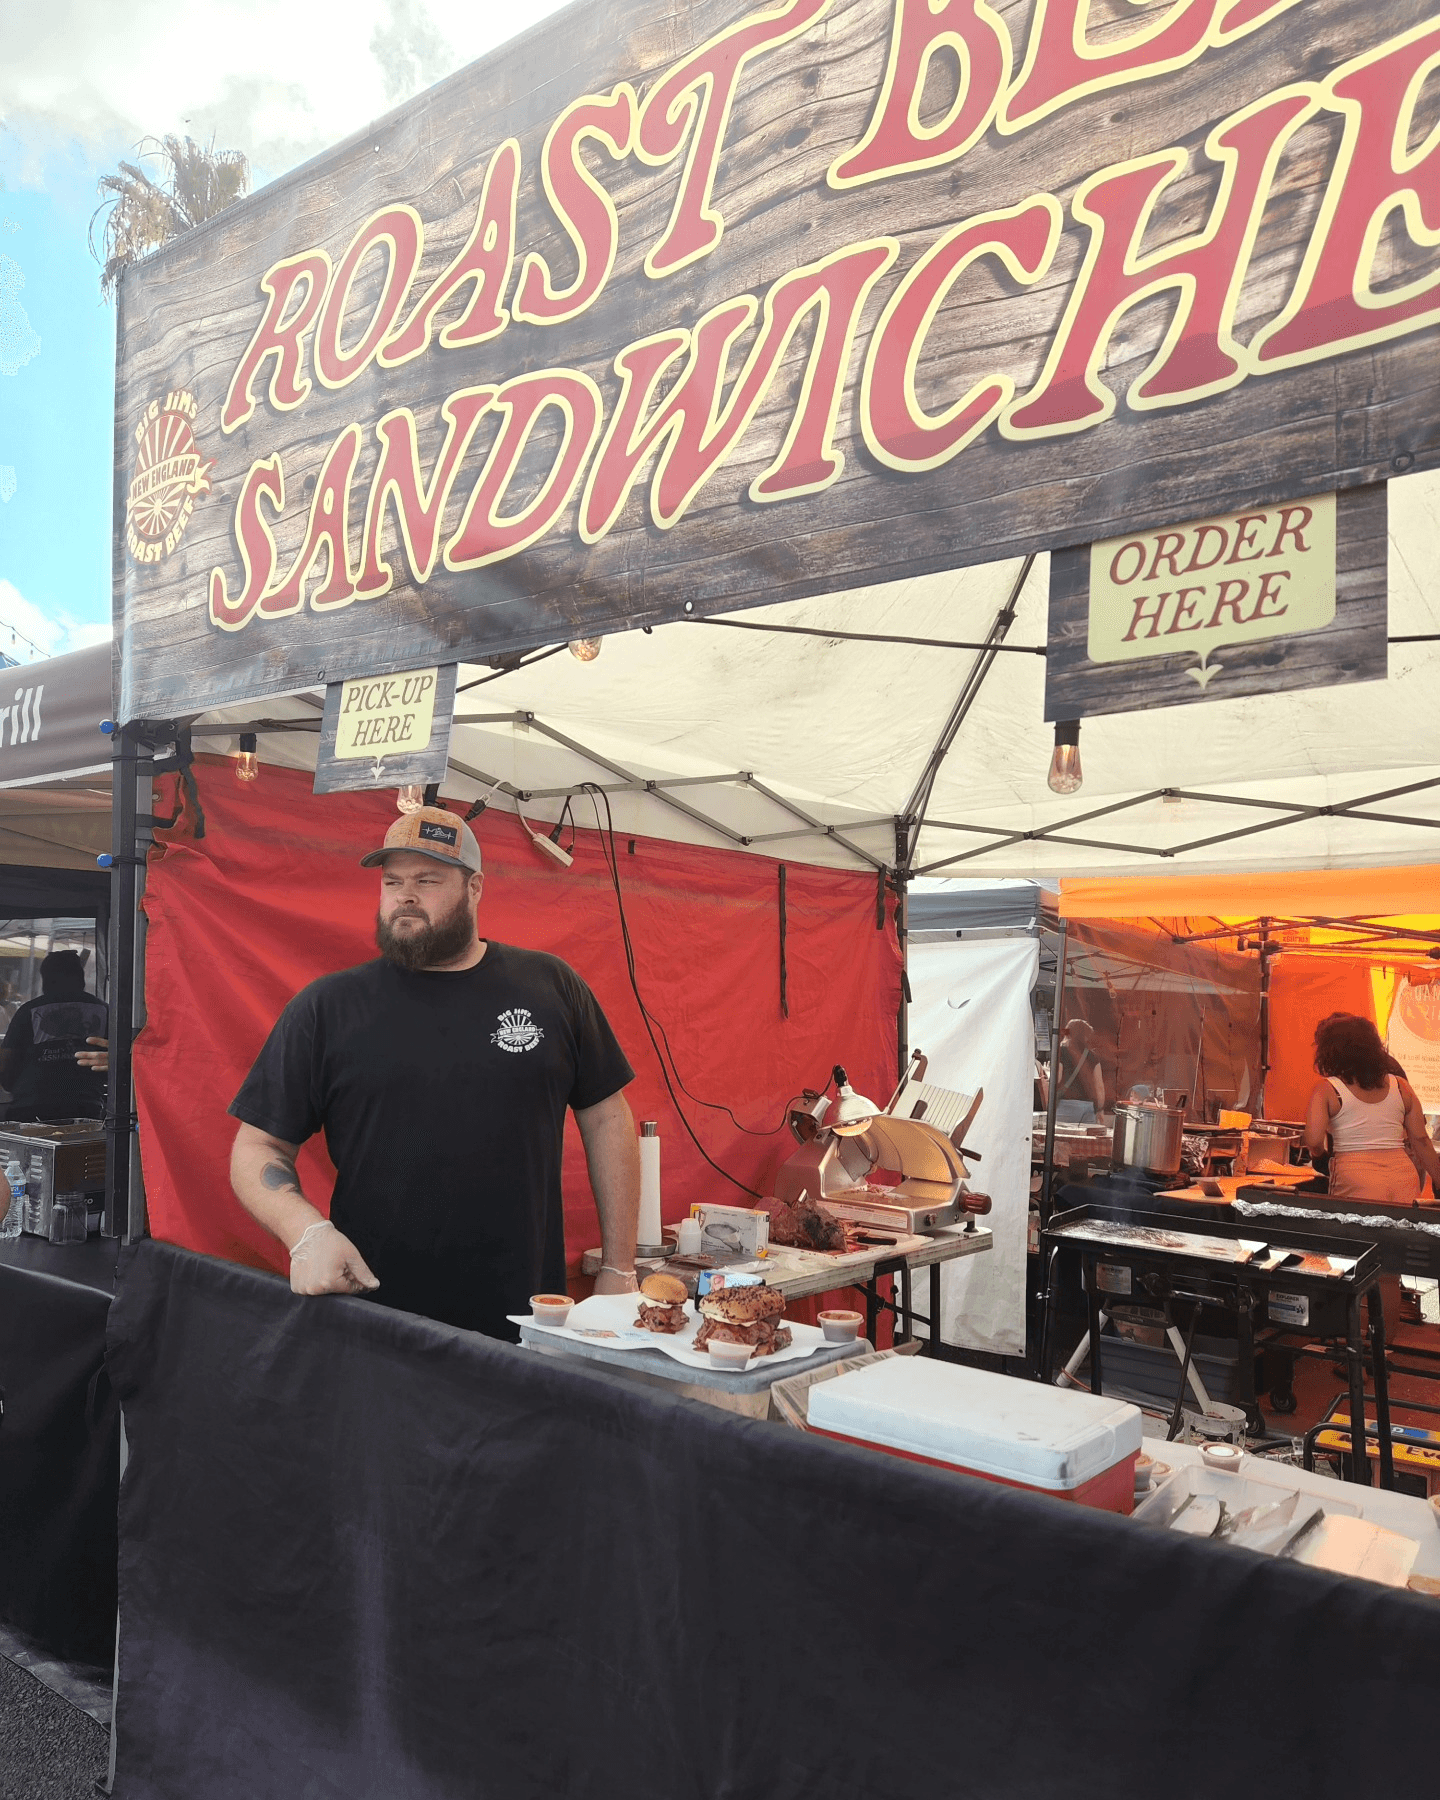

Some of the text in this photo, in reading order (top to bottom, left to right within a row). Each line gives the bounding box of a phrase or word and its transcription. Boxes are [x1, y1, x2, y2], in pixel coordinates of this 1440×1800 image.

[220, 0, 834, 434] ROAST
[132, 457, 196, 500] NEW ENGLAND
[126, 494, 195, 563] ROAST BEEF
[1109, 505, 1313, 586] ORDER
[1120, 570, 1292, 643] HERE
[342, 674, 434, 714] PICK-UP
[350, 713, 416, 747] HERE
[497, 1040, 523, 1053] ROAST
